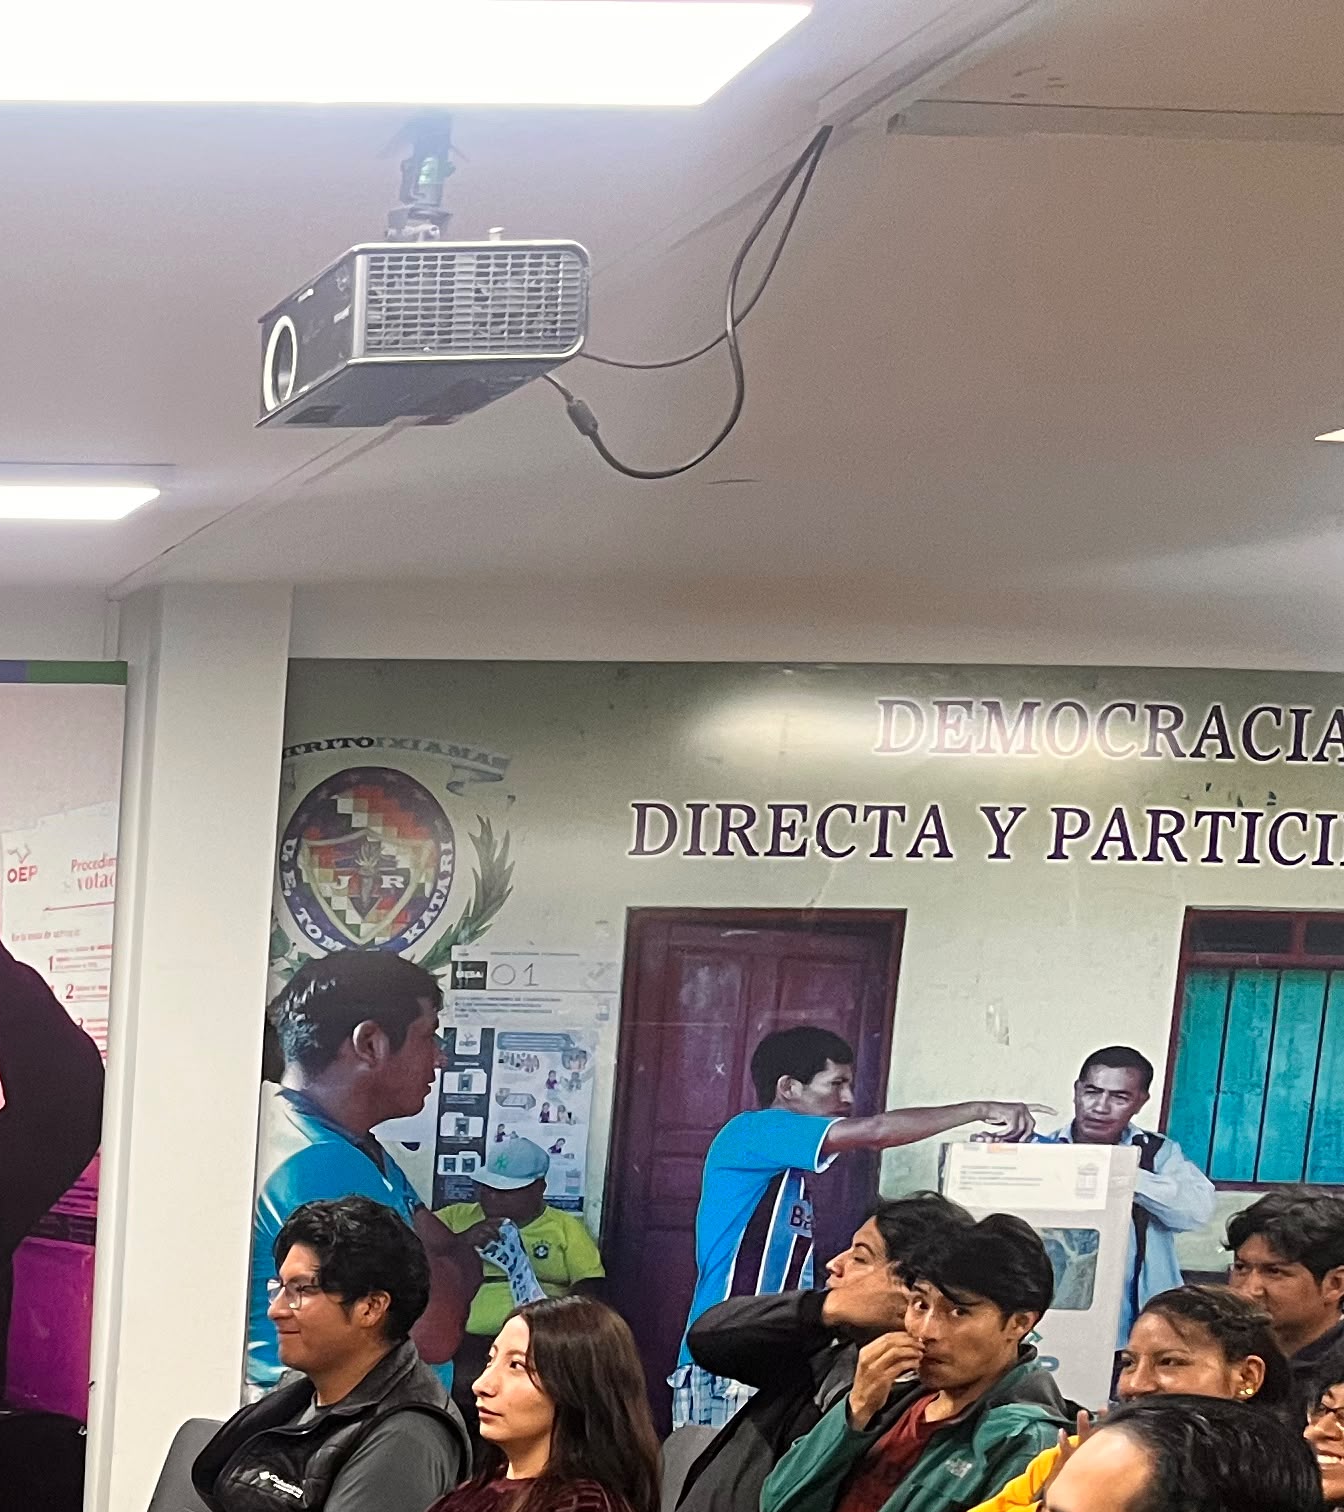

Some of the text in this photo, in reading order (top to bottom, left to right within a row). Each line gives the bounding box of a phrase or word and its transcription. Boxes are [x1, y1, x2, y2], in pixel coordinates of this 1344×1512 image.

[283, 736, 375, 759] TRITO
[874, 698, 1344, 763] DEMOCRACIA
[627, 801, 1344, 868] DIRECTA Y PARTICI
